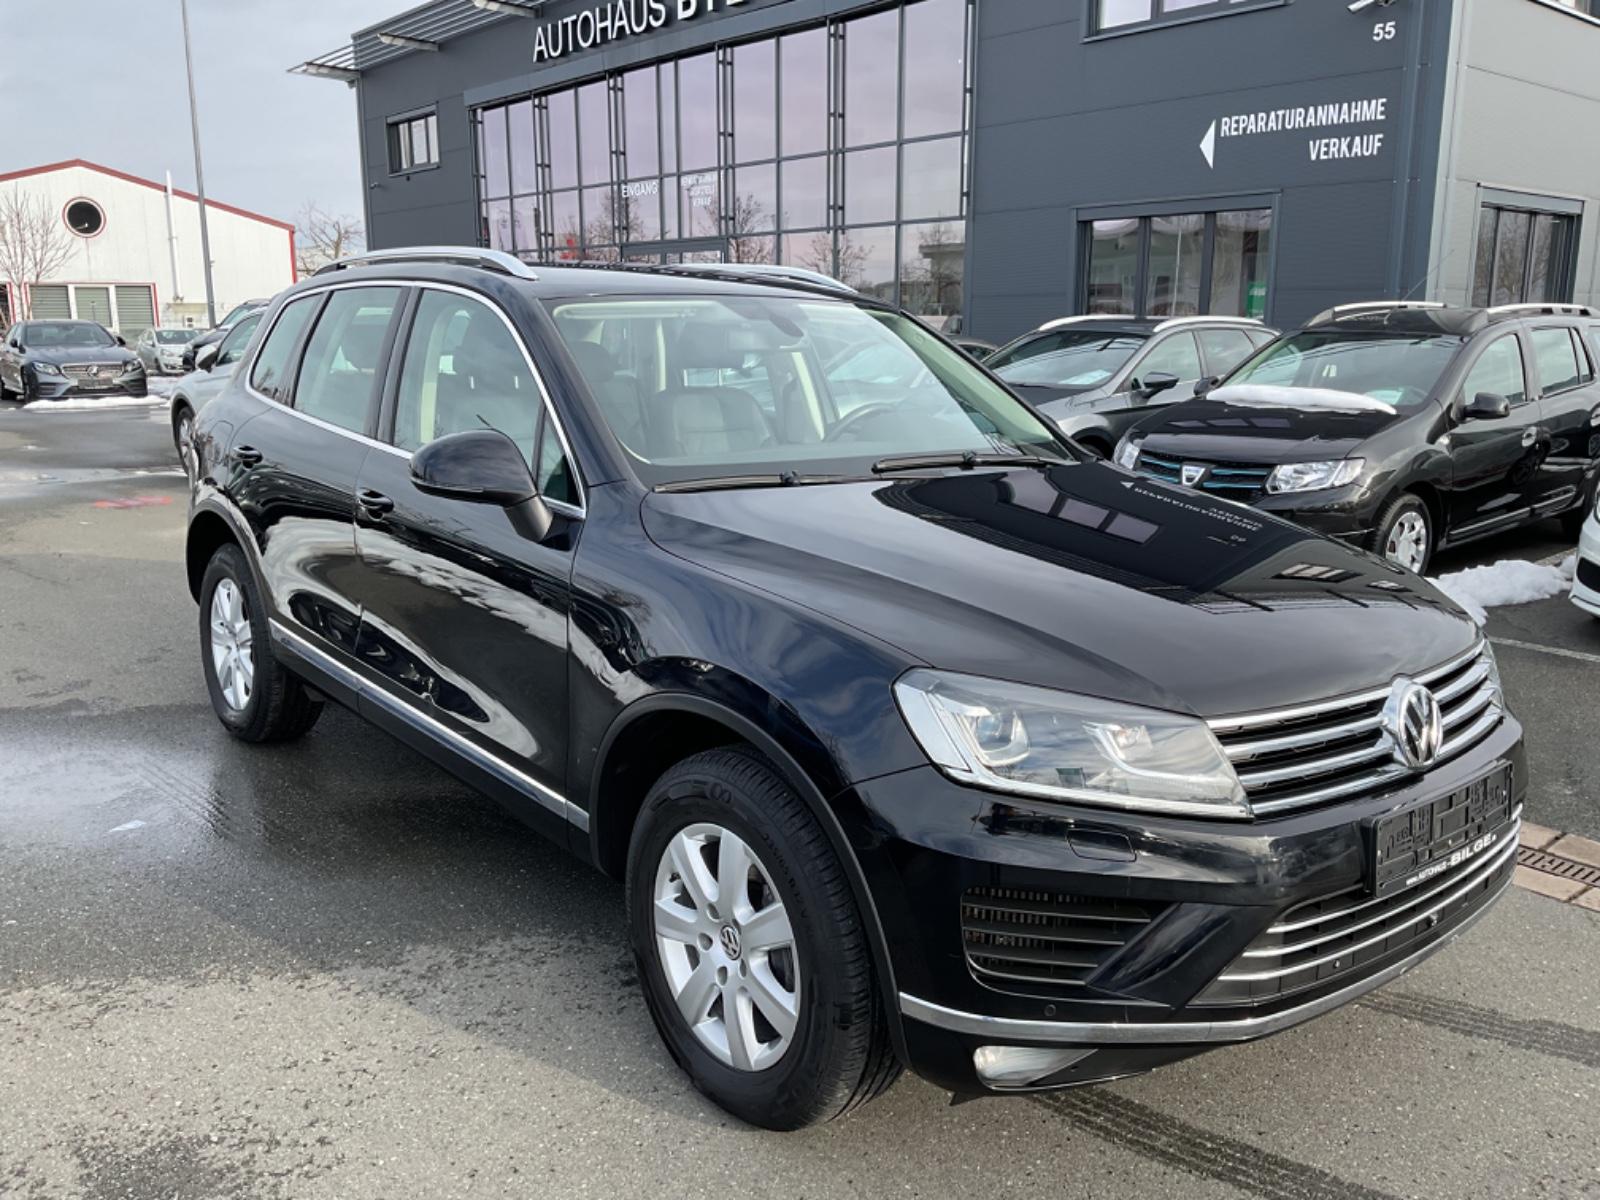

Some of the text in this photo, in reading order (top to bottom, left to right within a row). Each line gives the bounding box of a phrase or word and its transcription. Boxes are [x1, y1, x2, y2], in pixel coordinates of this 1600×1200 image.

[533, 0, 666, 63] AUTOHAUS
[1373, 21, 1396, 41] 55
[1221, 98, 1387, 137] REPARATURANNAHME
[1309, 134, 1384, 160] VERKAUF
